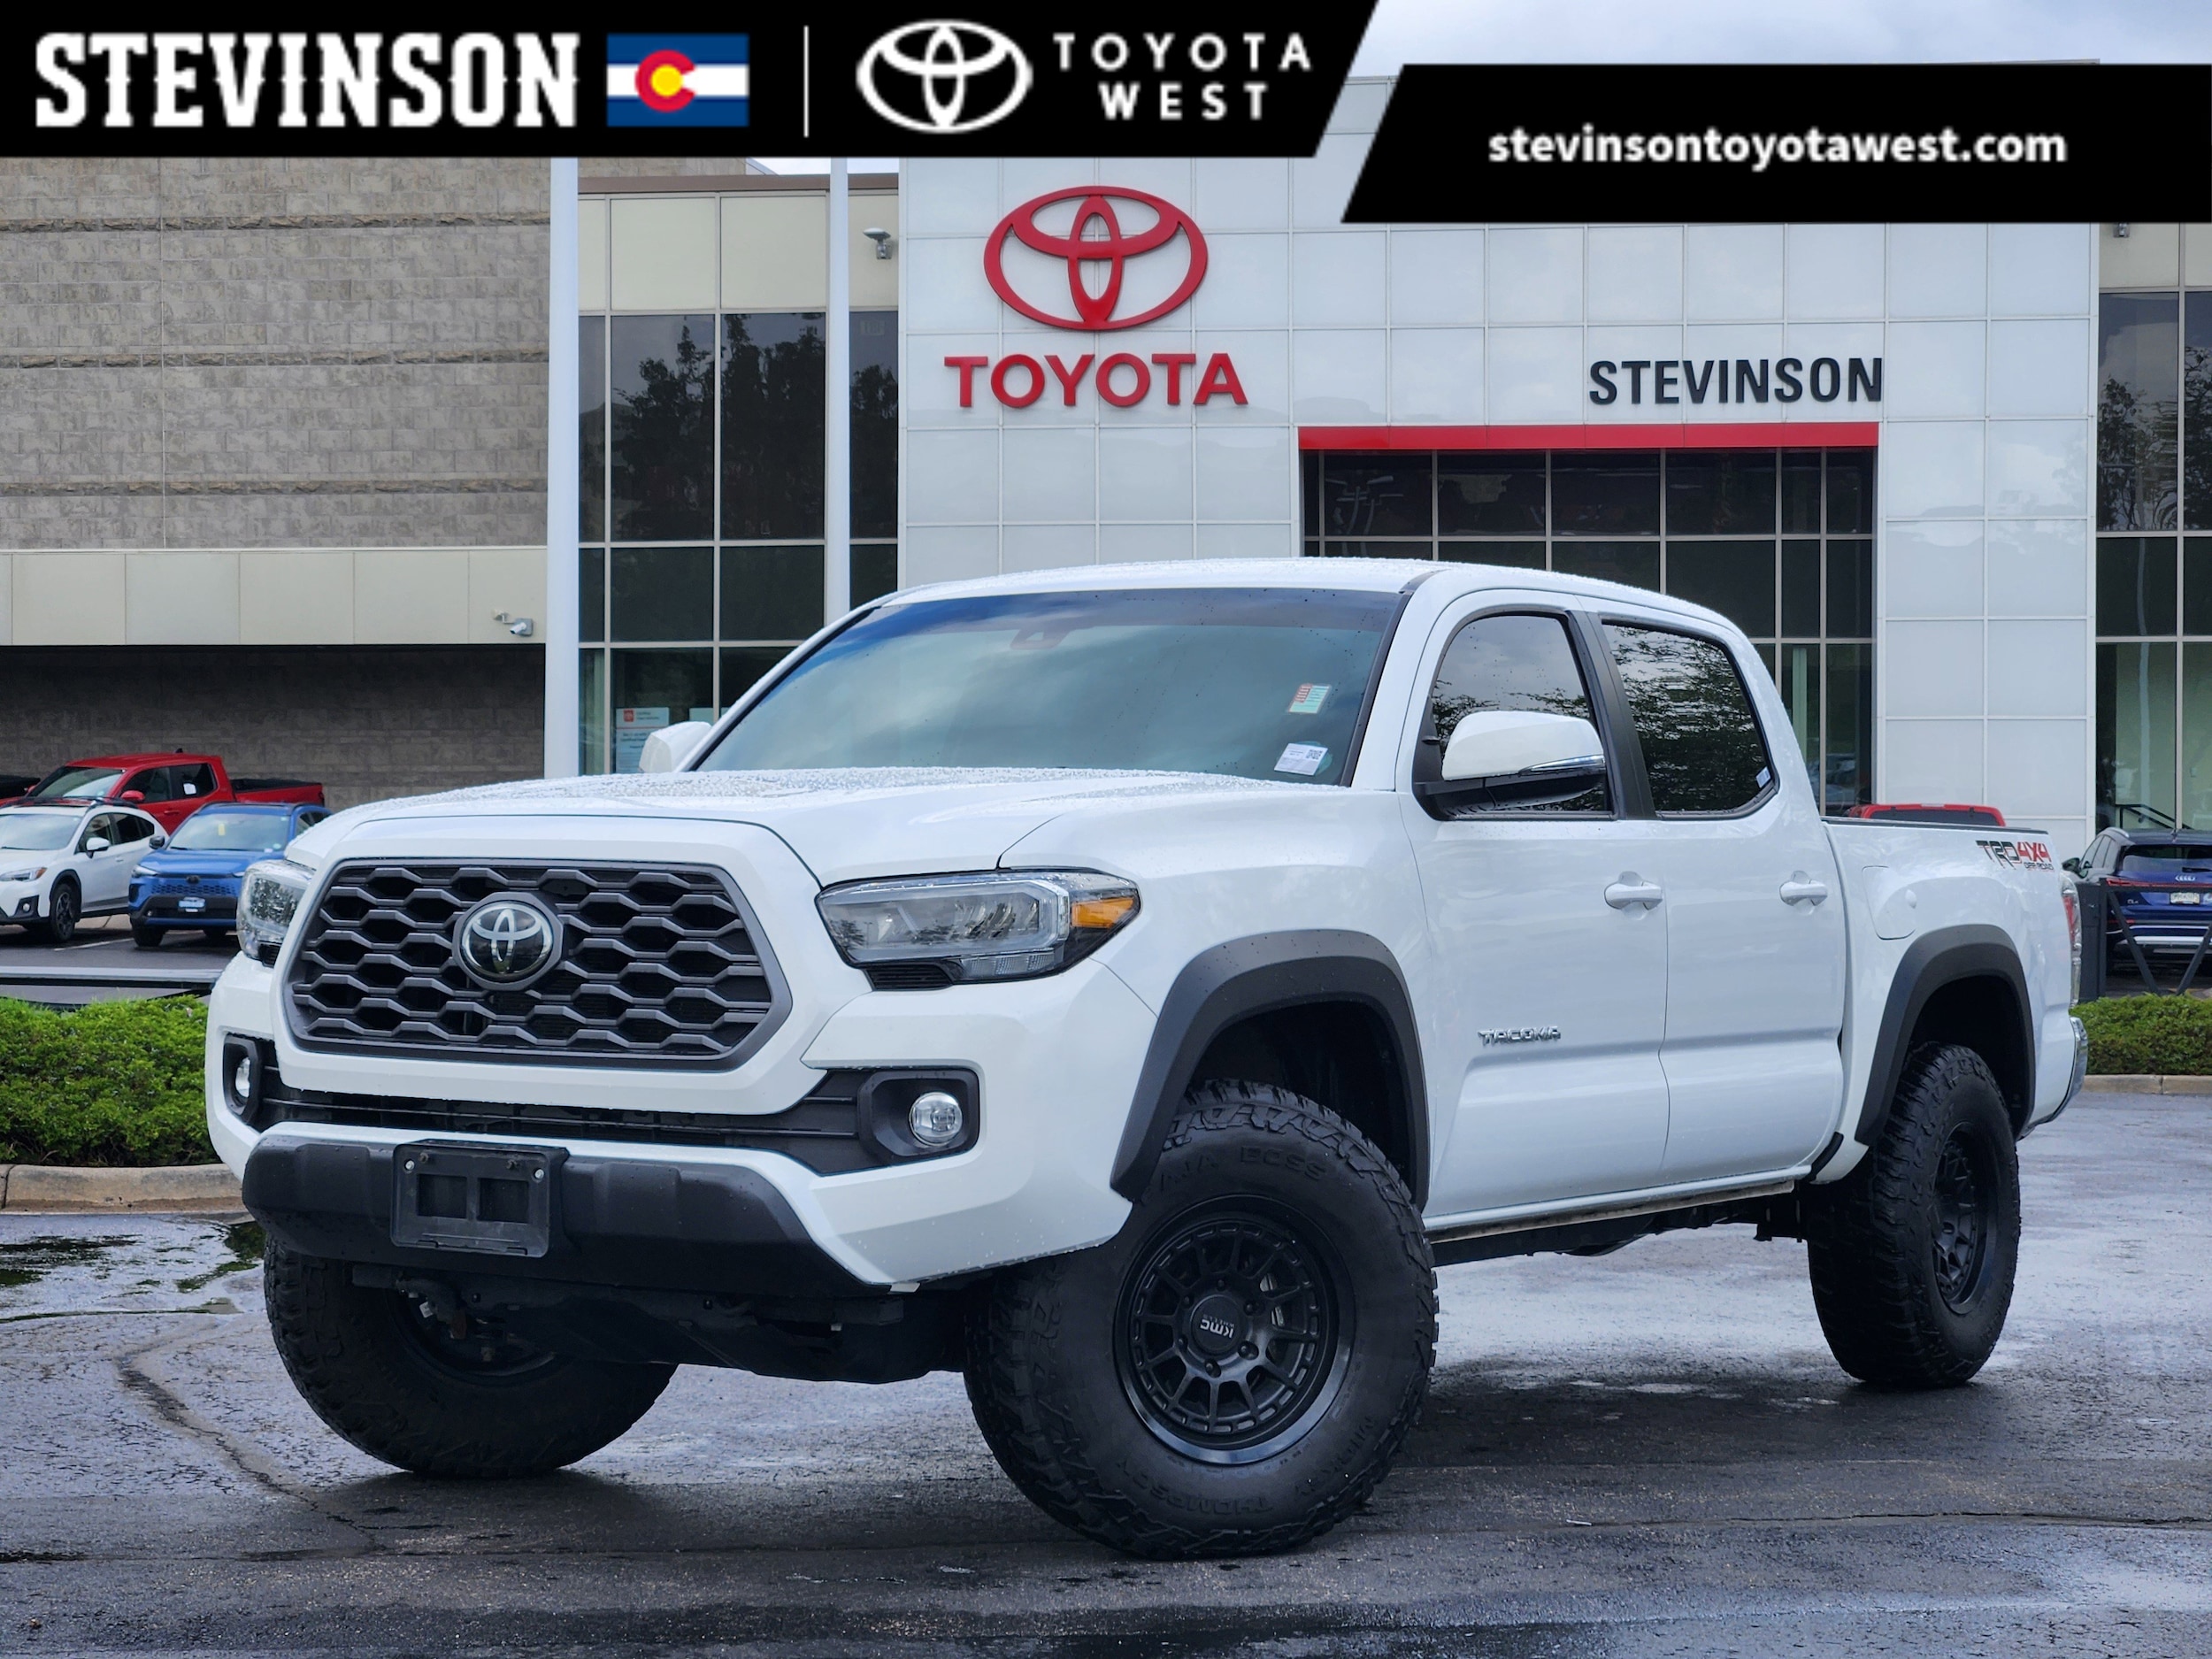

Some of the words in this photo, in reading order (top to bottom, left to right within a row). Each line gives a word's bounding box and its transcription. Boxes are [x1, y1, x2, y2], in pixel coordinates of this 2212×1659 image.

[945, 352, 1247, 408] TOYOTA
[1589, 356, 1883, 405] STEVINSON
[1975, 840, 2023, 870] TRD
[1478, 1025, 1561, 1046] TACOMA
[1200, 1318, 1234, 1339] KMC
